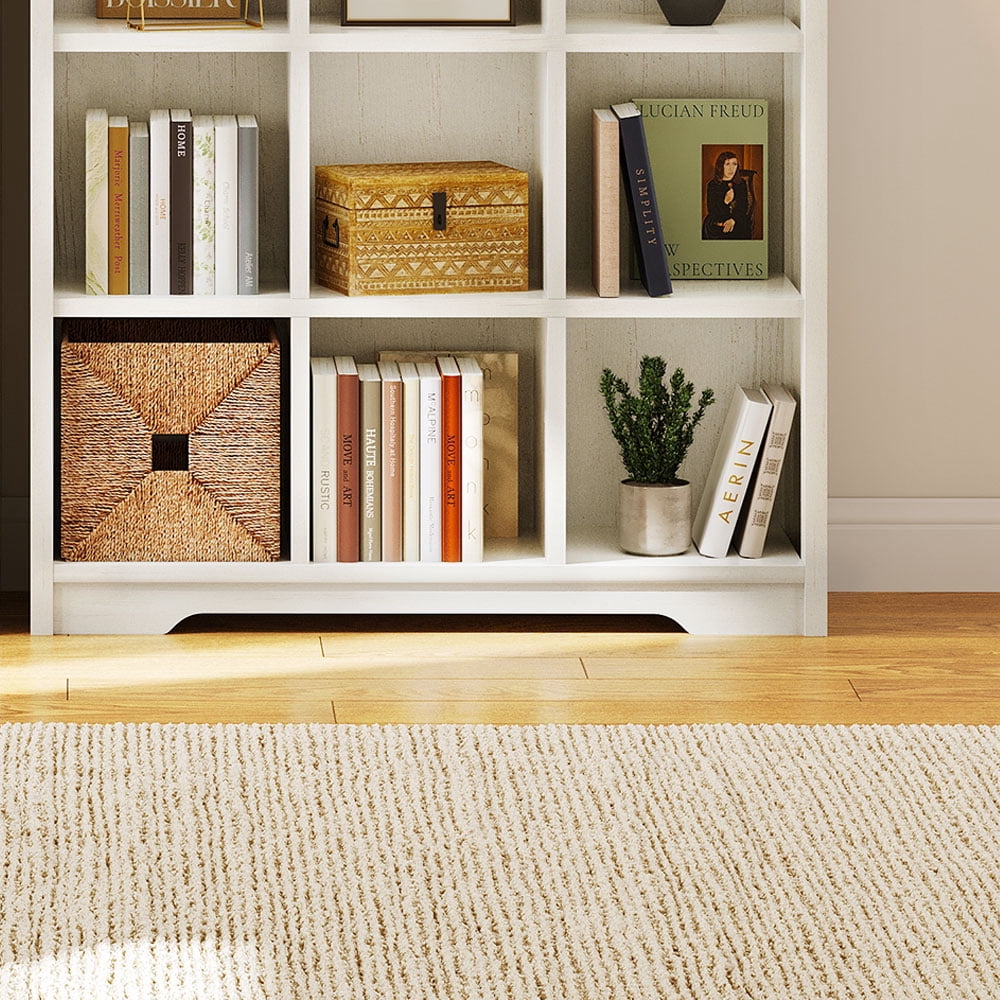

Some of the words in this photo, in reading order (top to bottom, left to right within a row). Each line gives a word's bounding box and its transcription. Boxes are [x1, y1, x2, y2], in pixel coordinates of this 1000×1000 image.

[639, 104, 704, 118] LUCIAN
[710, 104, 764, 118] FREUD
[177, 124, 186, 157] HOME
[635, 168, 657, 246] SIMPLITY
[113, 255, 123, 274] Post
[668, 262, 764, 277] SPECTIVES
[343, 434, 353, 466] MOVE
[366, 428, 376, 467] HAUTE
[447, 434, 456, 466] MOVE
[320, 470, 330, 511] RUSTIC
[343, 486, 353, 508] ART
[447, 486, 456, 508] ART
[718, 439, 755, 524] AERIN
